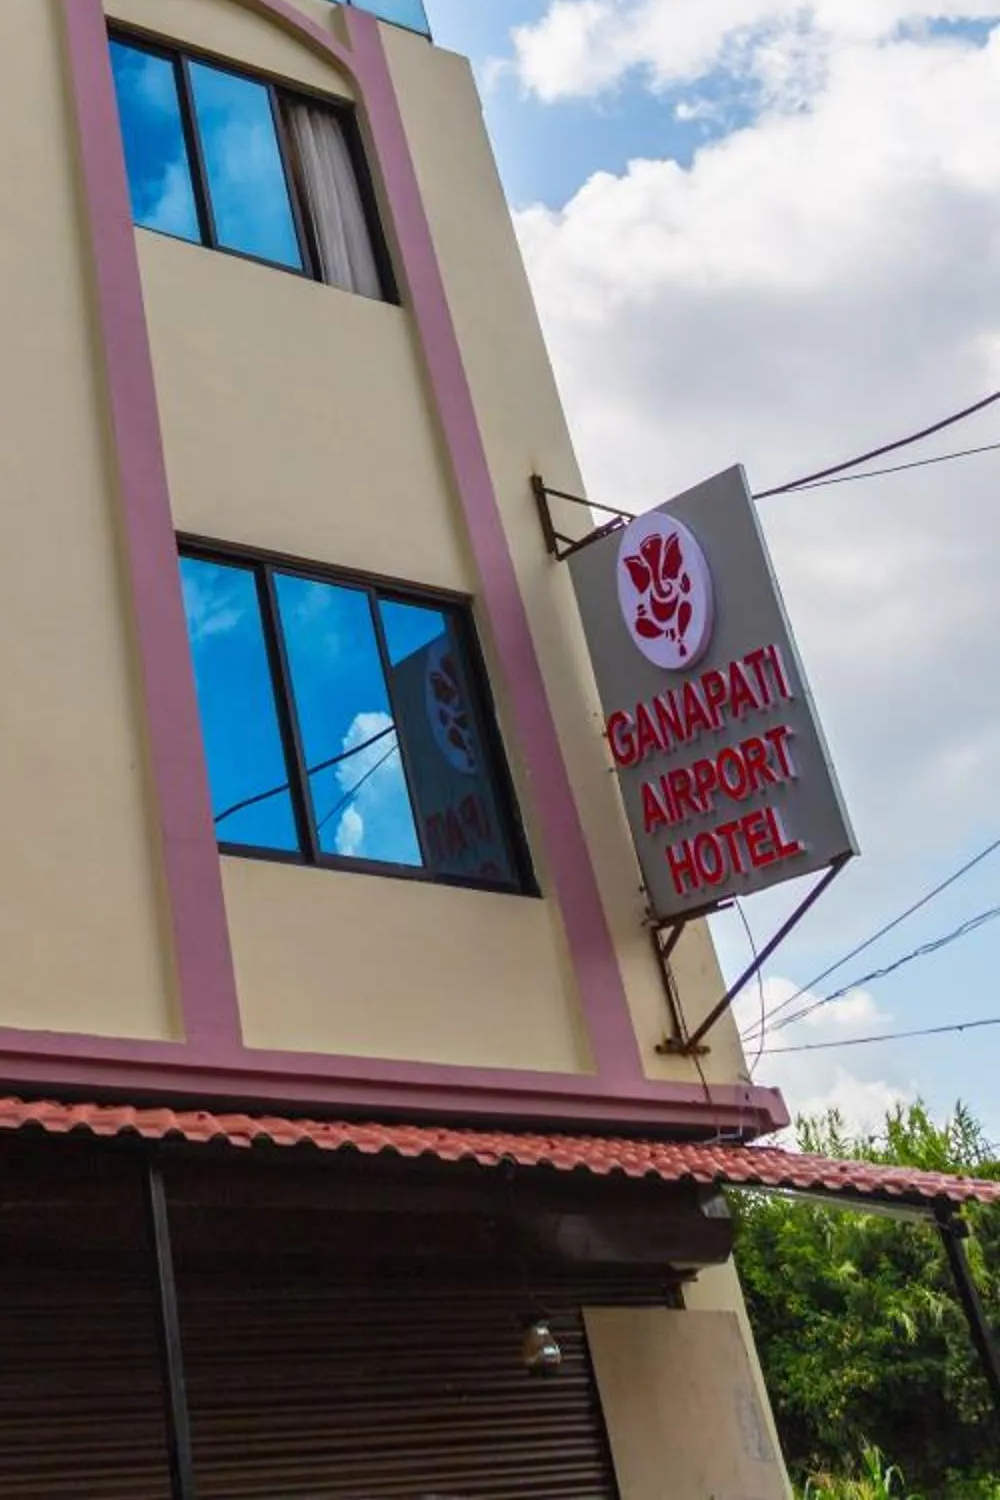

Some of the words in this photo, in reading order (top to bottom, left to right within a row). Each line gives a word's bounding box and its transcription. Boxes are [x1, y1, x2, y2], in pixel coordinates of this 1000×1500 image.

[606, 644, 791, 767] GANAPATI
[641, 725, 796, 835] AIRPORT
[665, 806, 804, 896] HOTEL
